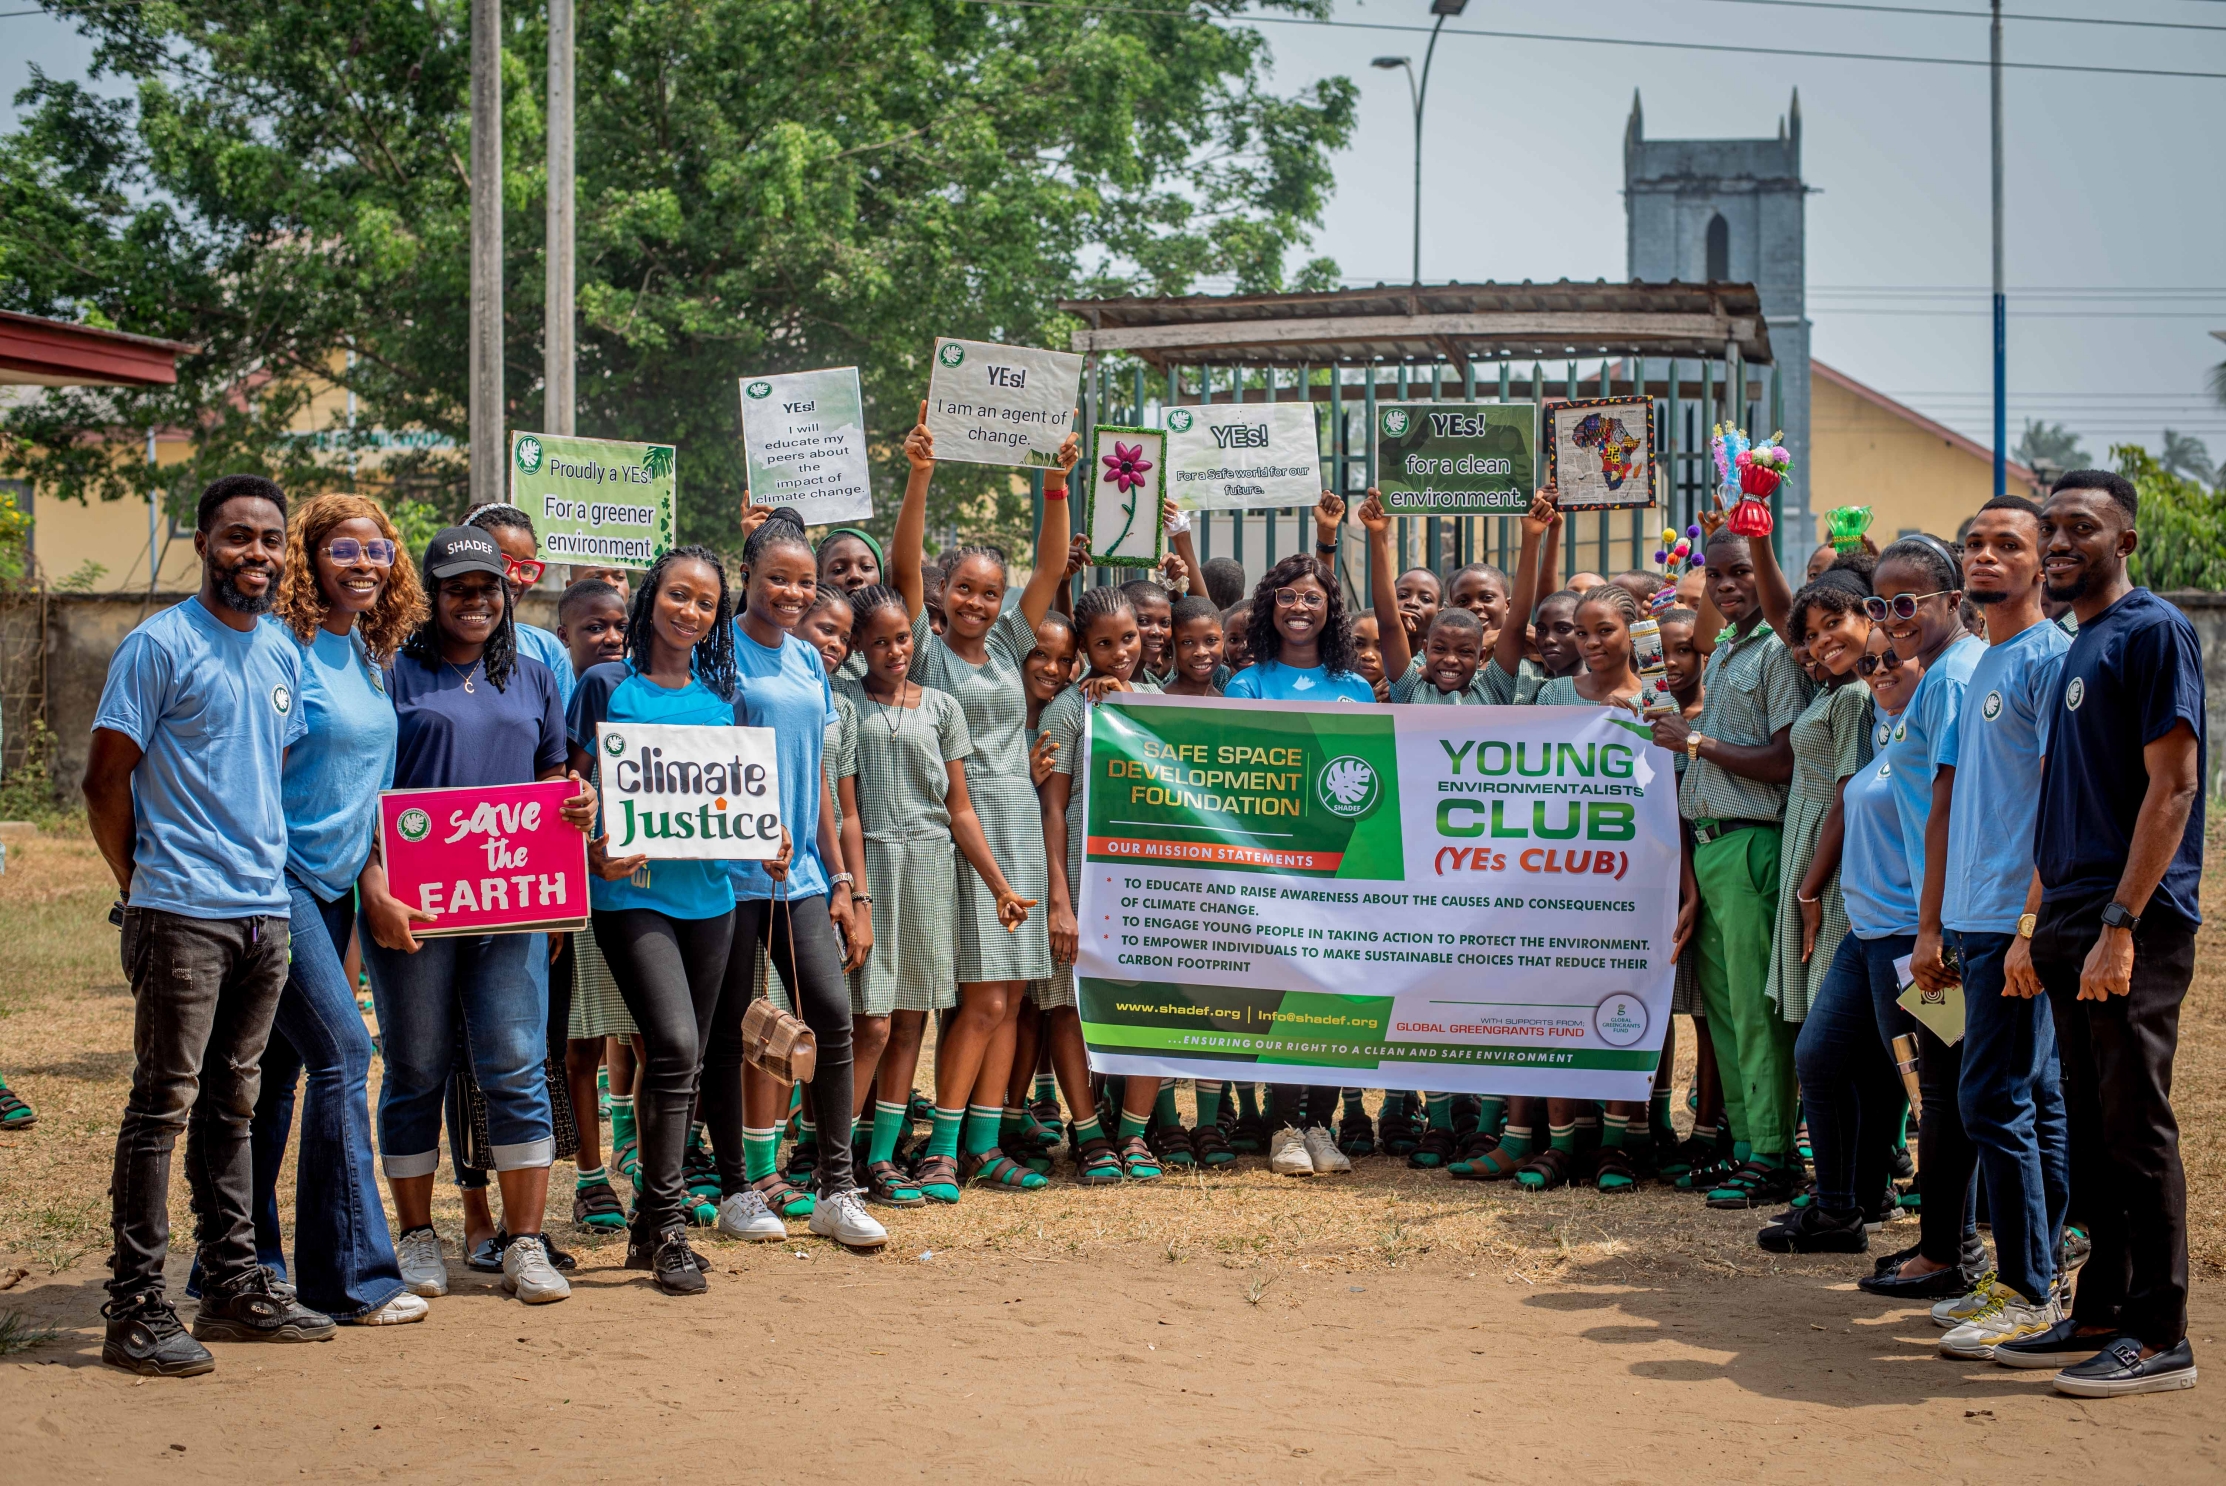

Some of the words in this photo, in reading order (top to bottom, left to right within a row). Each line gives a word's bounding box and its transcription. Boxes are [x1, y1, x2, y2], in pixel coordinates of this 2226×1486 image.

[988, 365, 1026, 388] YEs!
[783, 401, 815, 414] YEs!
[938, 399, 942, 412] I
[947, 403, 972, 415] am
[977, 406, 996, 418] an
[1002, 408, 1046, 424] agent
[1051, 411, 1068, 425] of
[789, 426, 792, 434] I
[796, 423, 819, 434] will
[968, 426, 1031, 447] change.
[1210, 424, 1268, 448] YEs!
[1430, 412, 1486, 438] YEs!
[765, 438, 820, 450] educate
[824, 435, 844, 445] my
[768, 452, 805, 464] peers
[810, 447, 849, 458] about
[798, 462, 820, 472] the
[1406, 454, 1438, 474] for
[1441, 459, 1452, 474] a
[1456, 454, 1510, 474] clean
[550, 459, 605, 484] Proudly
[610, 469, 617, 482] a
[622, 465, 653, 484] YEs!
[776, 476, 824, 489] impact
[828, 473, 842, 483] of
[1176, 470, 1198, 481] For
[1198, 472, 1206, 480] a
[1206, 468, 1234, 480] Safe
[1236, 467, 1268, 478] world
[1269, 466, 1287, 477] for
[1288, 466, 1309, 476] our
[756, 492, 806, 504] climate
[810, 486, 865, 498] change.
[1224, 485, 1265, 496] future.
[1390, 488, 1526, 507] environment.
[545, 497, 572, 518] For
[578, 504, 586, 519] a
[591, 504, 654, 525] greener
[447, 540, 492, 554] SHADEF
[548, 532, 651, 557] environment
[1143, 741, 1208, 764] SAFE
[1218, 746, 1302, 766] SPACE
[1439, 739, 1634, 778] YOUNG
[1108, 759, 1302, 791] DEVELOPMENT
[1131, 786, 1300, 816] FOUNDATION
[1438, 781, 1644, 797] ENVIRONMENTALISTS
[618, 796, 780, 847] Justice
[1436, 798, 1636, 841] CLUB
[479, 837, 528, 872] the
[1107, 842, 1140, 854] OUR
[1145, 844, 1212, 859] MISSION
[1218, 849, 1314, 867] STATEMENTS
[1434, 846, 1507, 876] (YEs
[1519, 848, 1629, 881] CLUB)
[418, 872, 566, 915] EARTH
[1124, 878, 1142, 889] TO
[1146, 879, 1203, 893] EDUCATE
[1206, 883, 1236, 895] AND
[1240, 886, 1277, 898] RAISE
[1280, 888, 1359, 904] AWARENESS
[1363, 893, 1409, 905] ABOUT
[1412, 895, 1437, 906] THE
[1441, 896, 1490, 908] CAUSES
[1494, 897, 1524, 909] AND
[1528, 898, 1636, 912] CONSEQUENCES
[1120, 897, 1138, 908] OF
[1142, 898, 1196, 912] CLIMATE
[1199, 902, 1259, 916] CHANGE.
[1122, 916, 1140, 927] TO
[1144, 917, 1199, 931] ENGAGE
[1202, 921, 1252, 934] YOUNG
[1256, 925, 1304, 938] PEOPLE
[1308, 928, 1323, 940] IN
[1328, 929, 1379, 942] TAKING
[1382, 932, 1433, 944] ACTION
[1438, 934, 1455, 945] TO
[1459, 934, 1516, 947] PROTECT
[1520, 936, 1545, 948] THE
[1549, 937, 1650, 951] ENVIRONMENT.
[1118, 954, 1173, 967] CARBON
[1177, 957, 1251, 973] FOOTPRINT
[1121, 934, 1139, 946] TO
[1143, 936, 1208, 950] EMPOWER
[1212, 941, 1298, 957] INDIVIDUALS
[1302, 947, 1319, 958] TO
[1323, 948, 1361, 960] MAKE
[1364, 950, 1453, 964] SUSTAINABLE
[1457, 953, 1514, 966] CHOICES
[1518, 955, 1551, 967] THAT
[1555, 957, 1606, 969] REDUCE
[1609, 958, 1648, 970] THEIR
[1116, 1002, 1241, 1020] www.shadef.org
[1258, 1010, 1378, 1029] Info@shadef.org
[1480, 1017, 1503, 1025] WITH
[1505, 1018, 1553, 1026] SUPPORTS
[1396, 1022, 1445, 1033] GLOBAL
[1450, 1024, 1544, 1036] GREENGRANTS
[1548, 1027, 1585, 1038] FUND
[1168, 1035, 1251, 1048] ...ENSURING
[1255, 1040, 1282, 1050] OUR
[1286, 1041, 1328, 1053] RIGHT
[1331, 1044, 1348, 1054] TO
[1352, 1046, 1360, 1055] A
[1364, 1046, 1405, 1056] CLEAN
[1409, 1047, 1437, 1058] AND
[1441, 1049, 1472, 1059] SAFE
[1476, 1050, 1574, 1063] ENVIRONMENT
